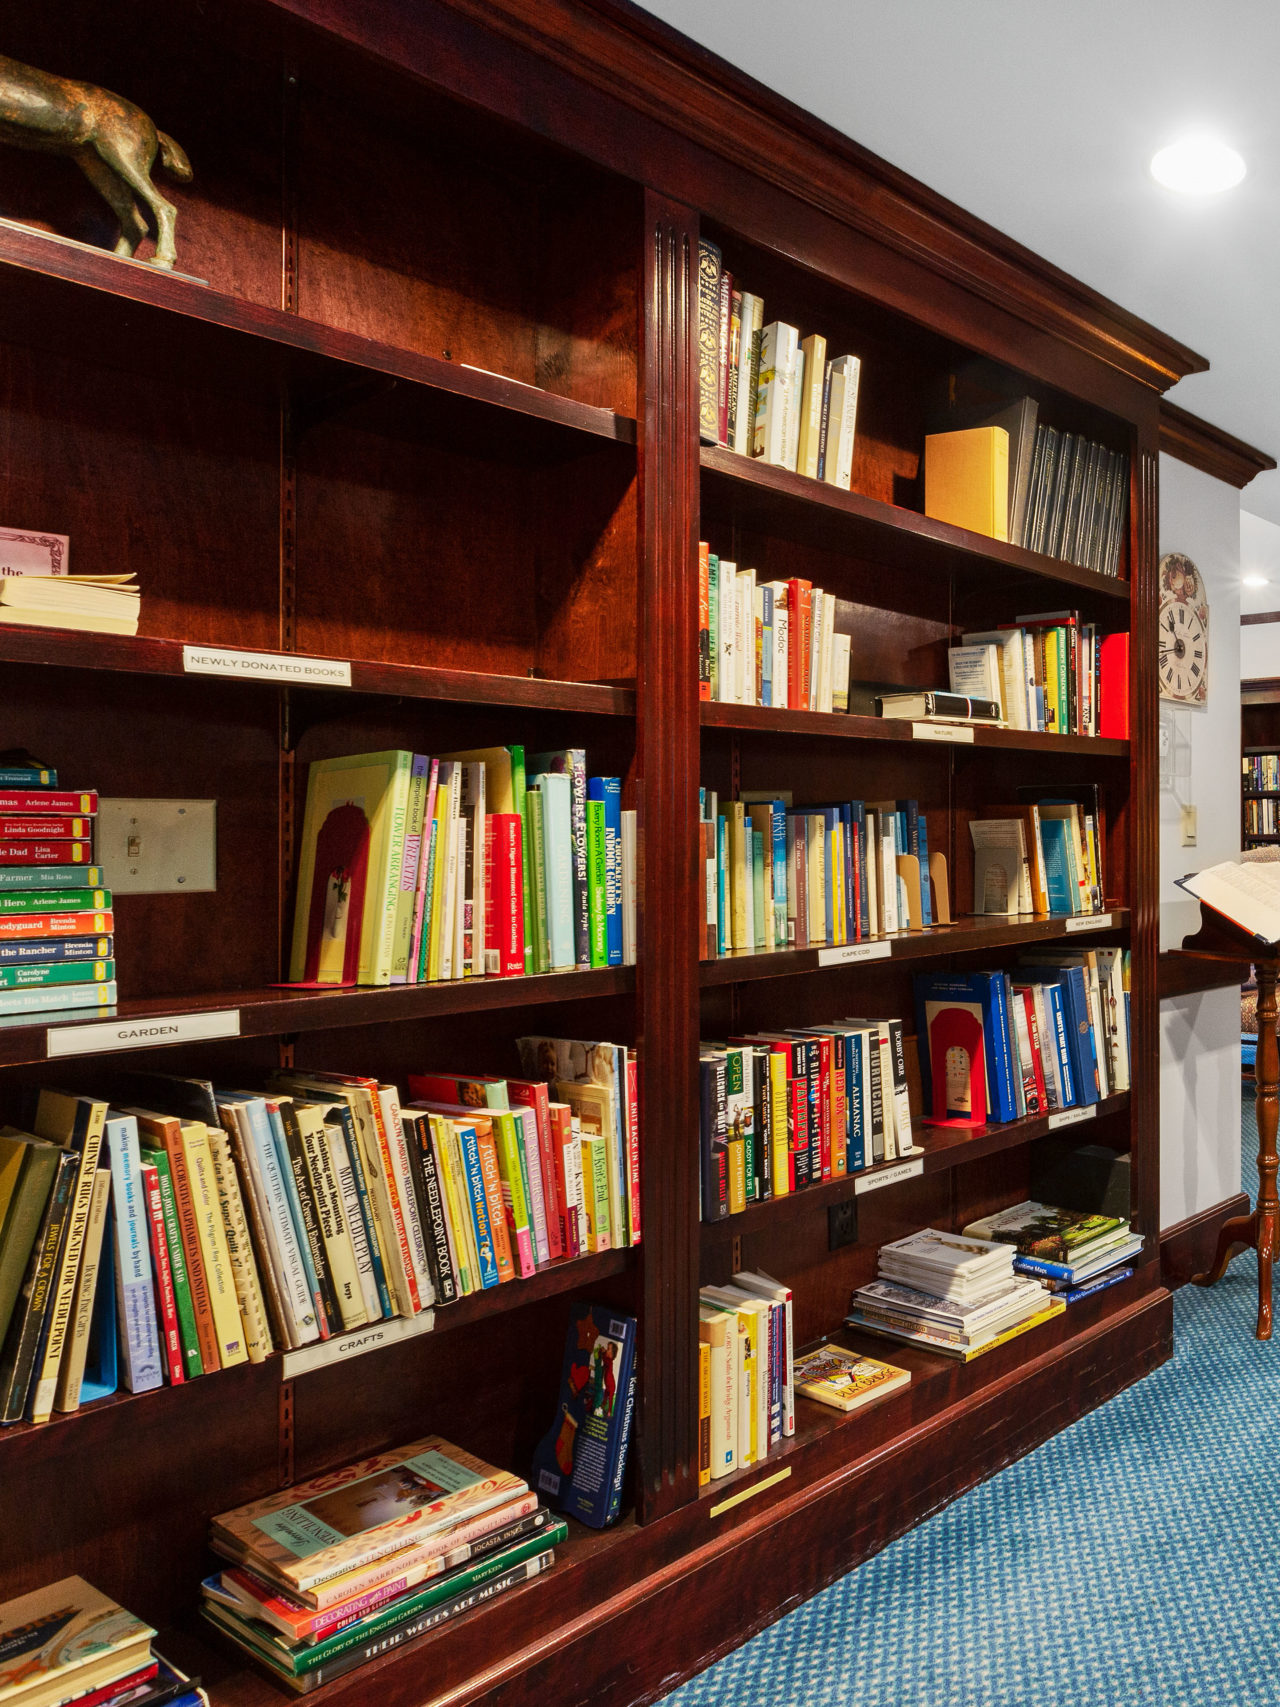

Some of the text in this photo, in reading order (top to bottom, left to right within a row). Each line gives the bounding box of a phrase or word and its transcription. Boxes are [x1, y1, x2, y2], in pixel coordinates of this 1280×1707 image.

[2, 567, 23, 577] the
[191, 656, 345, 677] NEWLY DONATED BOOKS
[777, 619, 787, 654] Modoc
[392, 807, 406, 847] FLOWER
[402, 777, 422, 892] complete book WREATHS
[576, 823, 587, 881] FLOWERS!
[592, 804, 603, 884] Every Garden
[386, 850, 401, 911] ARRANGING
[605, 827, 616, 914] INDOOR GARDEN
[18, 946, 56, 956] Rancher
[118, 1026, 179, 1039] GARDEN
[894, 1031, 905, 1076] BOBBY ORR
[732, 1056, 742, 1091] OPEN
[870, 1050, 882, 1124] HURRICANE
[796, 1080, 808, 1149] FAITHFUL
[834, 1071, 846, 1150] RED SOX NATION
[852, 1086, 861, 1137] ALMANAC
[120, 1128, 140, 1249] making memory books and journals
[195, 1158, 210, 1206] Quilts Color
[304, 1133, 334, 1239] Your Needlepoint Pieces
[316, 1130, 345, 1235] Finishing and Mounting
[390, 1103, 418, 1224] CAROLYN NEEDLEPOINT
[594, 1158, 608, 1202] Knit's End
[867, 1175, 888, 1186] SPORTS
[894, 1168, 912, 1178] GAMES
[150, 1190, 163, 1221] HOLD IT!
[160, 1175, 184, 1283] HOLLY-JOLLY CRAFTS UNDER $10
[174, 1153, 207, 1315] DECORATIVE ALPHABETS AND INITIALS
[263, 1143, 308, 1305] THE ULTIMATE VISUAL GUIDE
[292, 1157, 326, 1279] The Art Crewel Embroidery
[339, 1167, 372, 1275] MORE NEEDLEPLAY
[421, 1154, 451, 1277] THE NEEDLEPOINT BOOK
[475, 1202, 488, 1236] Nation
[535, 1207, 545, 1231] GIFT
[32, 1224, 60, 1312] JEWELS FOR CROWN
[48, 1135, 101, 1359] CHINESE RUGS DESIGNED FOR NEEDLEPOINT
[207, 1224, 226, 1294] Pilgrim Roy Collection
[393, 1208, 413, 1280] BARBARA HAMMET
[340, 1332, 384, 1351] CRAFTS
[614, 1377, 637, 1491] Knit Christmas Stockings!
[428, 1543, 449, 1557] BOOK
[474, 1524, 523, 1553] JOCASTA INNES
[314, 1561, 357, 1585] Decorative
[314, 1577, 407, 1629] DECORATING PAINT
[471, 1563, 503, 1582] MARY KEEN
[307, 1603, 424, 1665] THE GLORY THE ENGLISH GARDEN
[365, 1576, 514, 1658] THEIR WORDS ARE MUSIC
